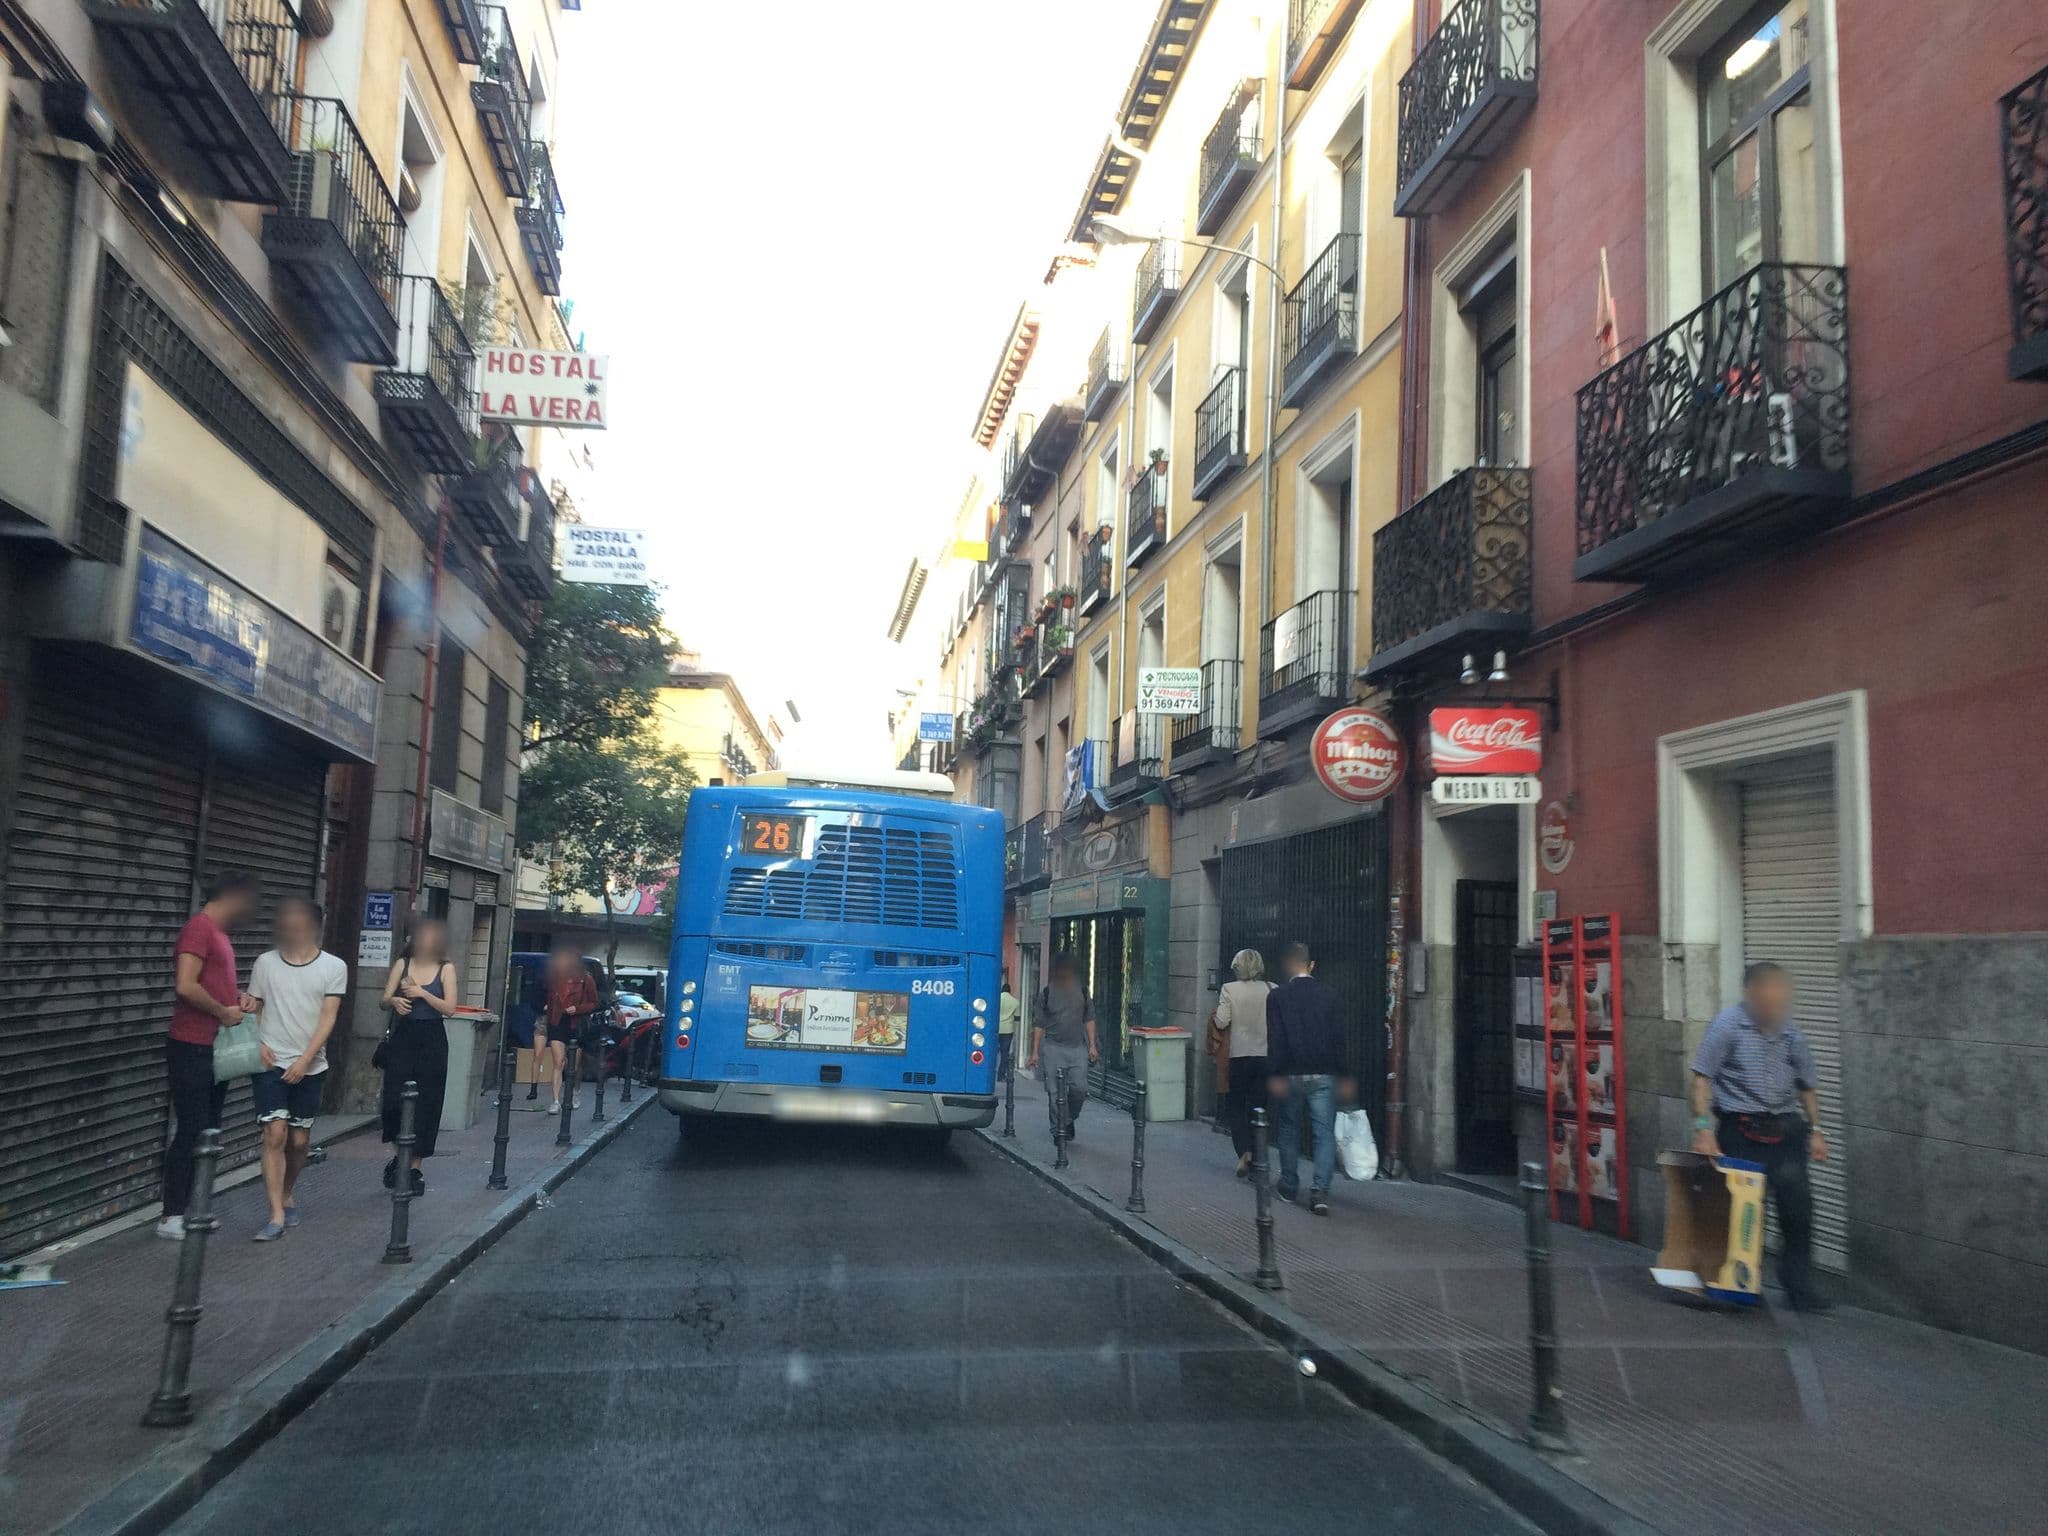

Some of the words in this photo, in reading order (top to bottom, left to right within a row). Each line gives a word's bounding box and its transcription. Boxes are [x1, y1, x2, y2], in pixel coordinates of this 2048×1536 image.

[487, 351, 603, 380] HOSTAL
[482, 392, 518, 416] LA
[529, 396, 603, 422] VERA
[570, 529, 632, 544] HOSTAL
[575, 544, 638, 559] ZABALA
[1157, 672, 1199, 681] TECNOCASA
[1448, 717, 1541, 746] Coca-Cola
[1327, 741, 1398, 762] Mahou
[1444, 782, 1488, 799] MESON
[1495, 782, 1508, 798] EL
[754, 821, 790, 850] 26
[1124, 886, 1138, 898] 22
[719, 965, 741, 974] EMT
[911, 980, 955, 995] 8408
